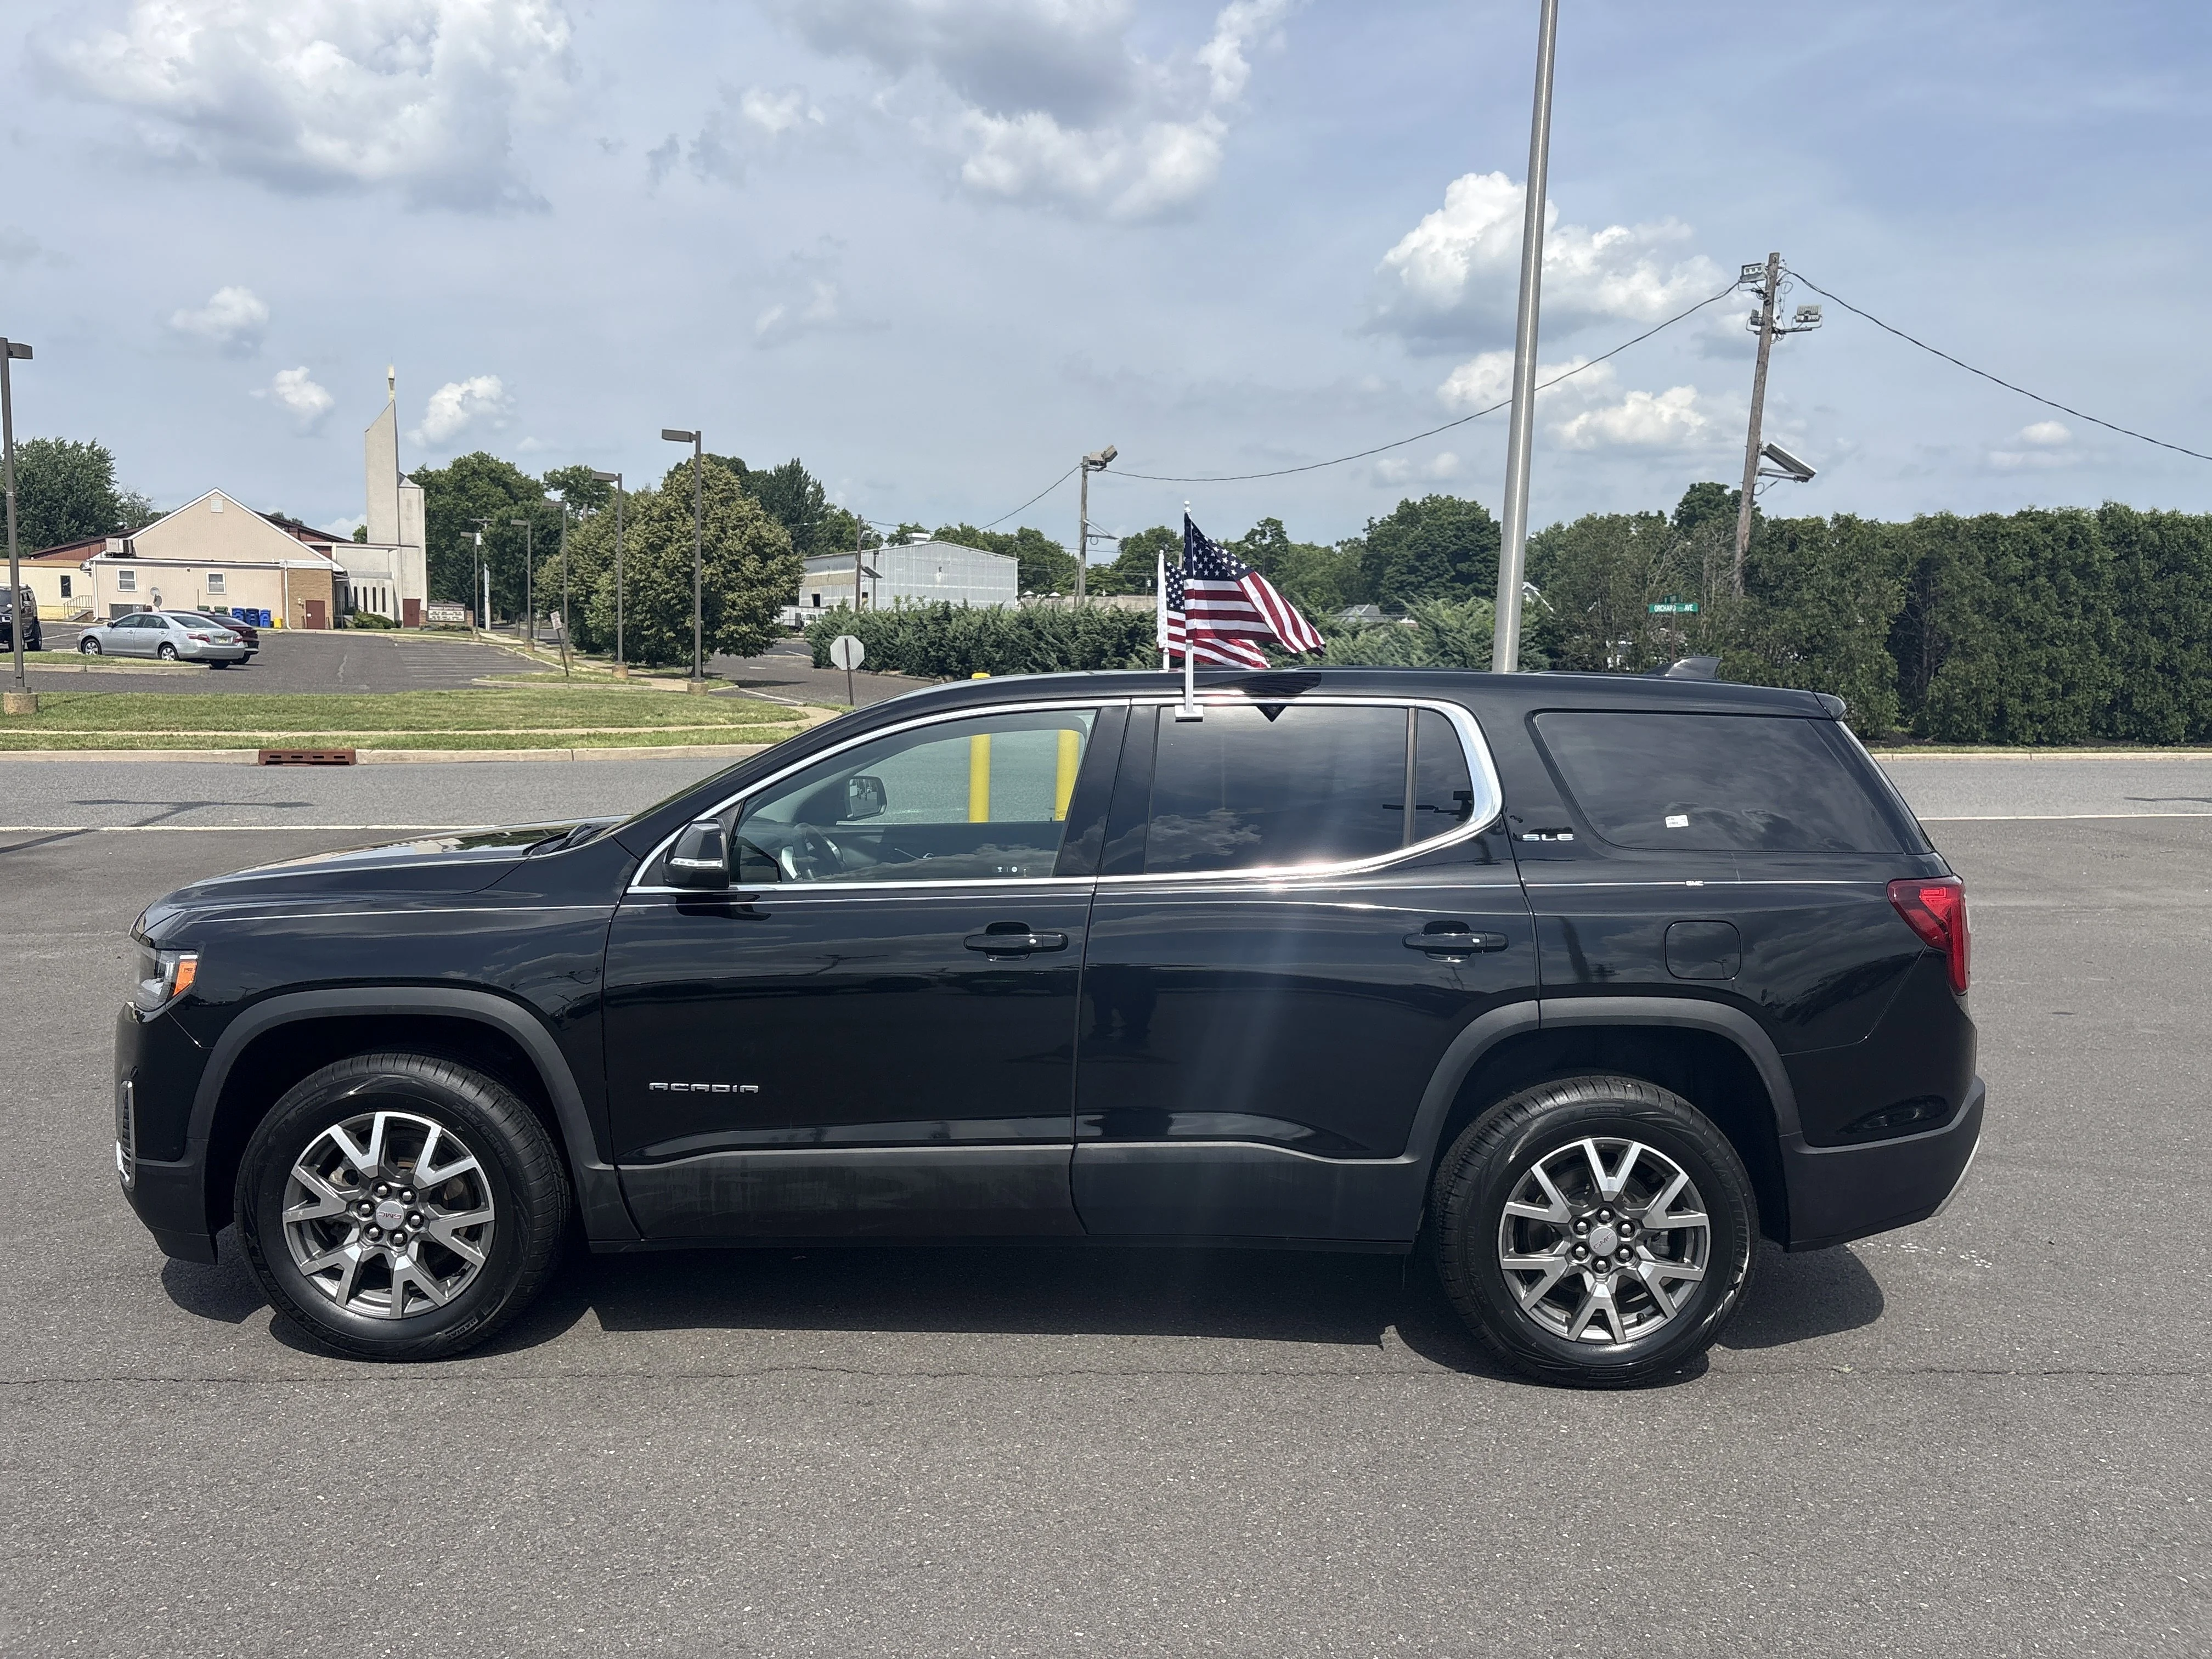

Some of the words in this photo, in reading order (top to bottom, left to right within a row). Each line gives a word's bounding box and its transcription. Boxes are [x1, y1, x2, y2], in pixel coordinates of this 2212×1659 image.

[649, 1082, 759, 1093] ACADIA
[377, 1211, 402, 1220] GMC
[1593, 1233, 1613, 1249] GMC
